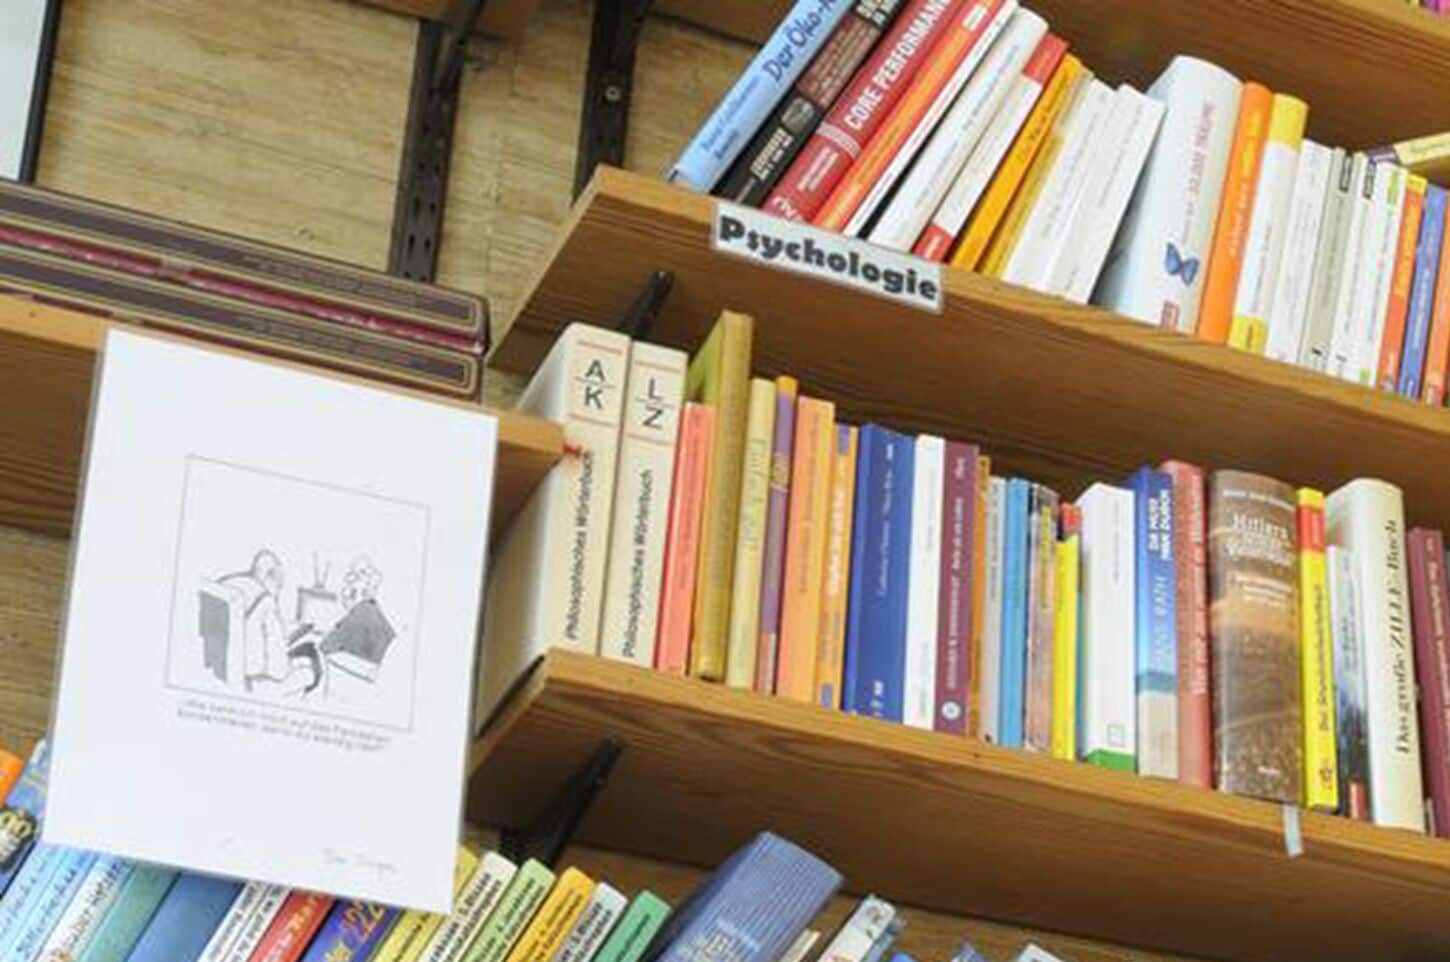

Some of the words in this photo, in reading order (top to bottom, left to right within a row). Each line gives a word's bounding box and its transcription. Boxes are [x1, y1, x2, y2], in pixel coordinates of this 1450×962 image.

[760, 39, 798, 82] Der
[785, 0, 834, 49] Öko-
[842, 82, 883, 131] CORE
[716, 214, 938, 300] Psychologie
[584, 359, 607, 383] A
[645, 378, 661, 404] L
[584, 386, 606, 409] K
[642, 406, 664, 430] Z
[575, 449, 592, 528] Wörterbuch
[1230, 511, 1290, 542] Hitlers
[565, 532, 587, 639] Philosophisches
[622, 548, 646, 657] Philosophisches
[634, 468, 652, 546] Wörterbuch
[1390, 654, 1410, 711] große
[1395, 716, 1408, 753] Das
